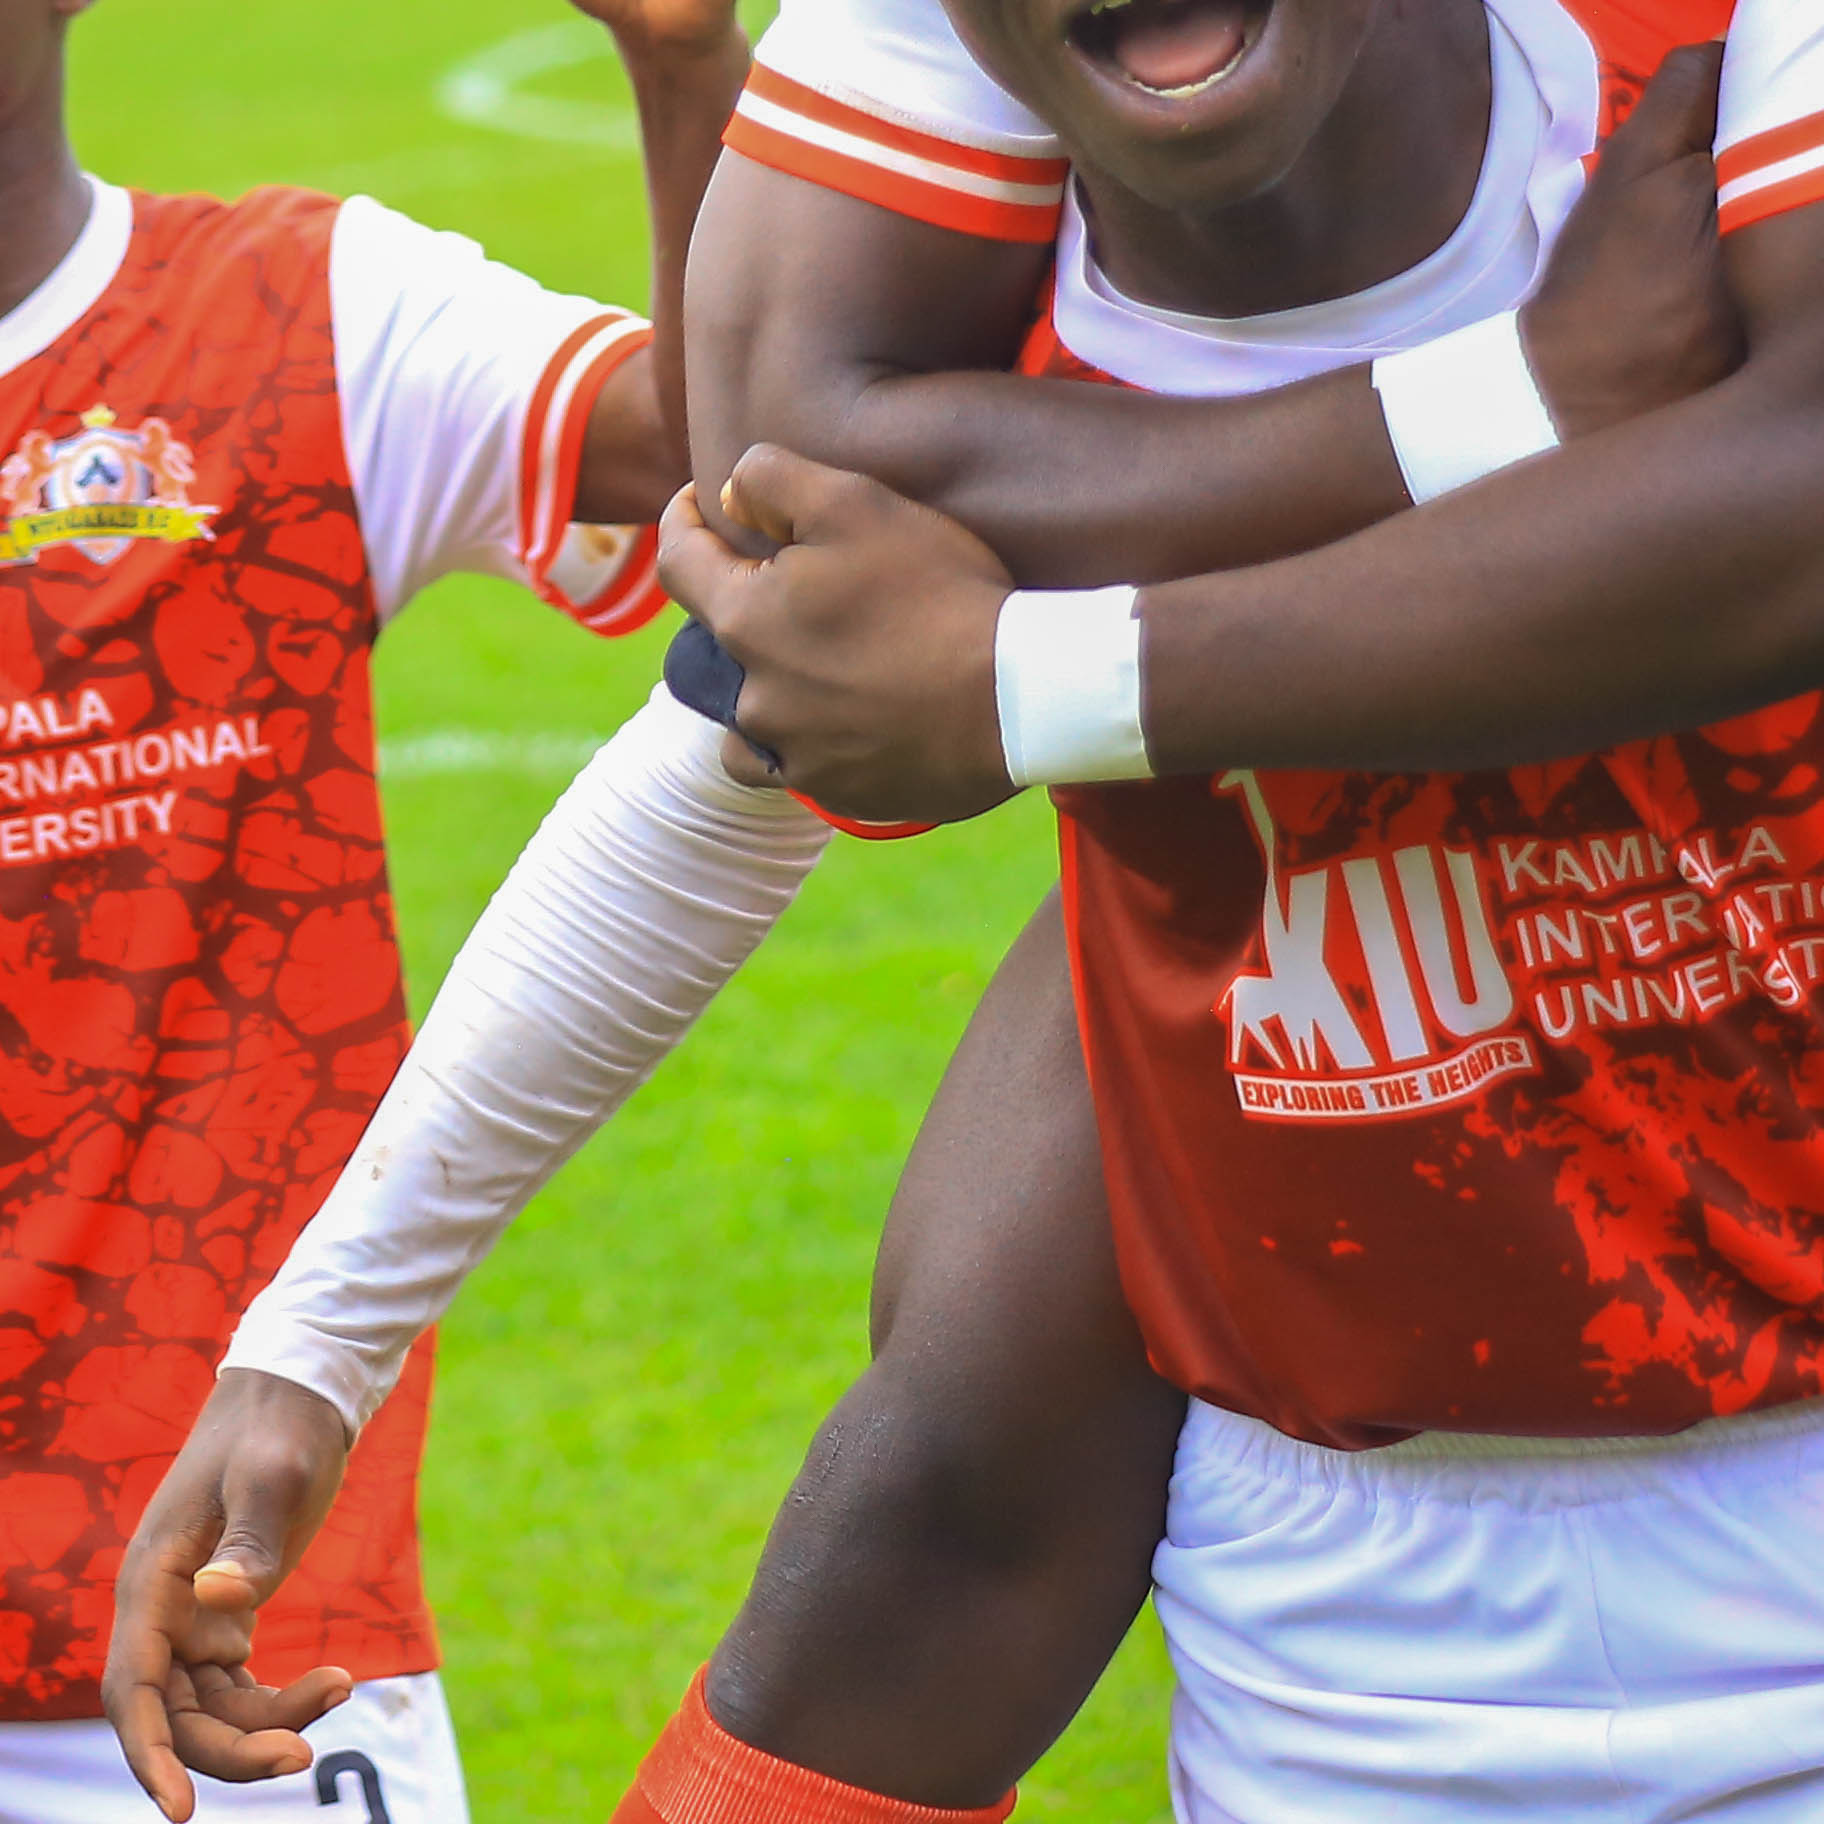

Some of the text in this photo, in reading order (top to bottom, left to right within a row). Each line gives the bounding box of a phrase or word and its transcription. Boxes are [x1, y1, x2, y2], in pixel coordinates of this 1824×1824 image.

[1218, 769, 1514, 1070] KIU
[1242, 1039, 1526, 1112] EXPLORING THE HEIGHTS
